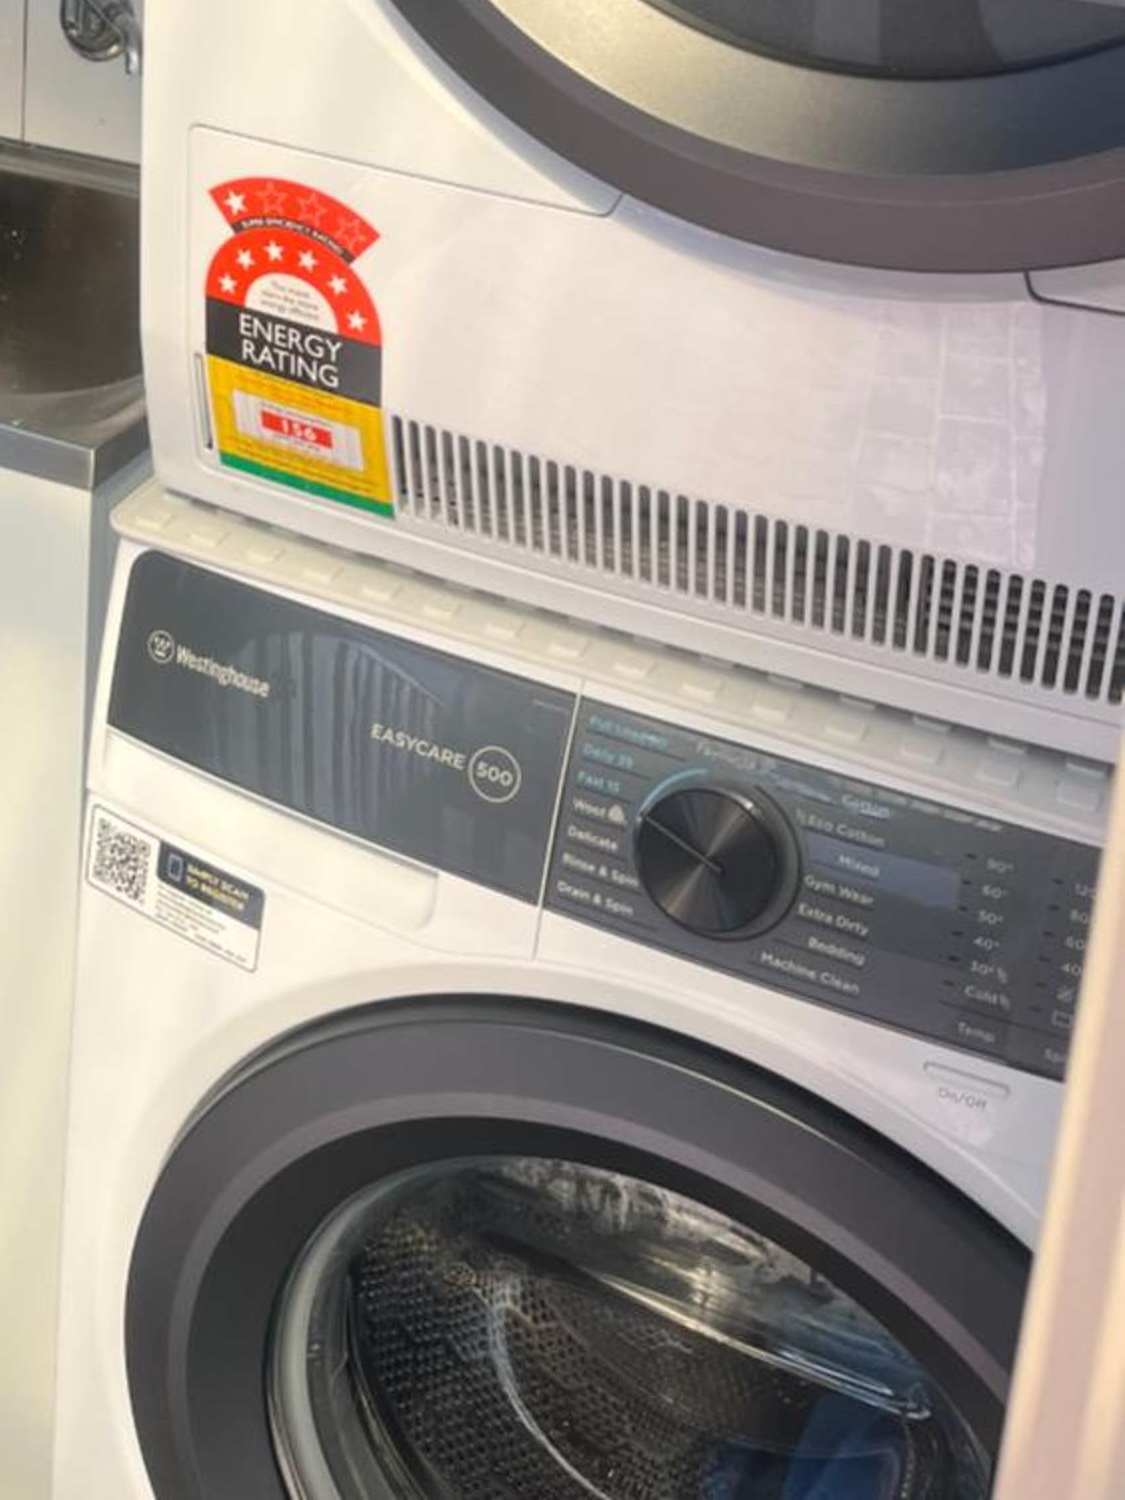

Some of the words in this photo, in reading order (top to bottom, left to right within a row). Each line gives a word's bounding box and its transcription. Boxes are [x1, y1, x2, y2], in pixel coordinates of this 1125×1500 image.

[239, 313, 342, 363] ENERGY
[242, 340, 339, 388] RATING
[283, 419, 317, 441] 156
[176, 644, 270, 699] Westinghouse
[372, 724, 466, 770] EASYCARE
[476, 761, 513, 788] 500
[568, 825, 618, 852] Delicate
[836, 823, 886, 847] Cotton
[562, 852, 595, 873] Rinse
[839, 855, 879, 878] Mixed
[556, 881, 590, 900] Drain
[605, 898, 634, 918] Spin
[804, 874, 835, 893] Gym
[838, 885, 874, 904] Wear
[798, 902, 833, 924] Extra
[835, 915, 868, 937] Dirty
[808, 936, 865, 967] Bedding
[761, 951, 816, 980] Machine
[819, 972, 860, 996] Clean
